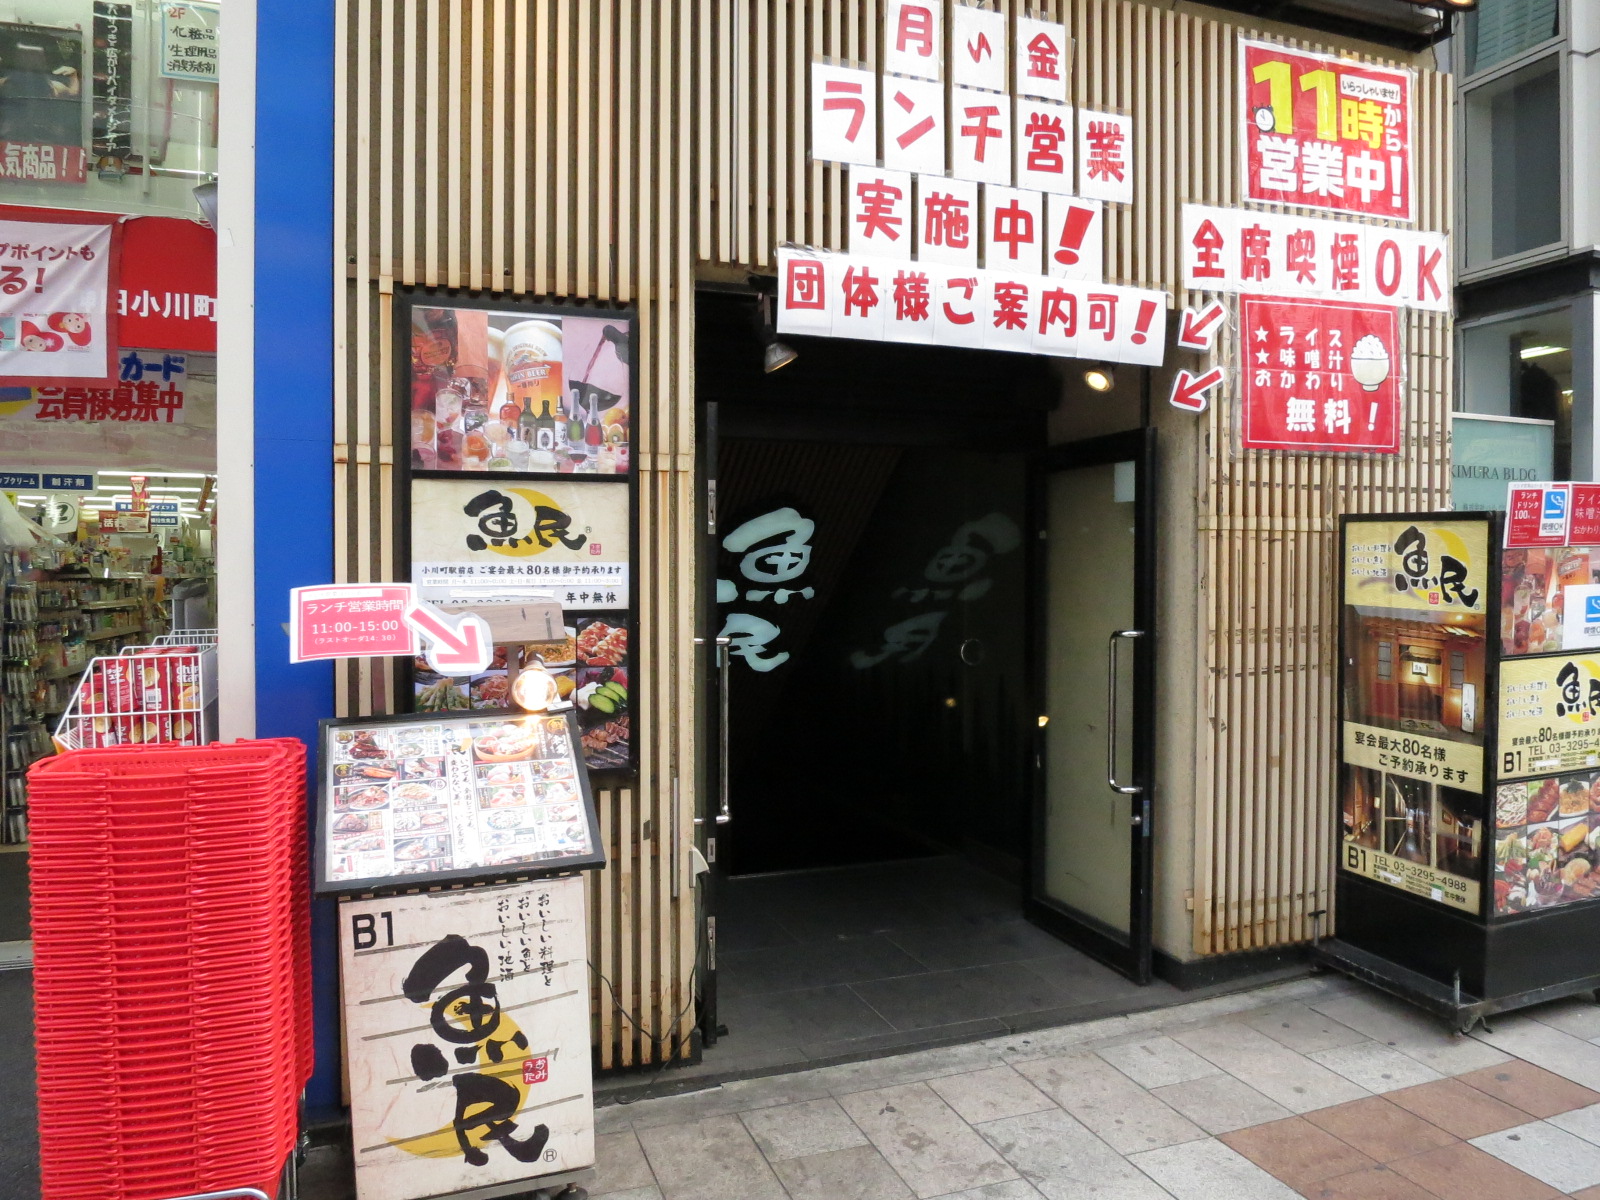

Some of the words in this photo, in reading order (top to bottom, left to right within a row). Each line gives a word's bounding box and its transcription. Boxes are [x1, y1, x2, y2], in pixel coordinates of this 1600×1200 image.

[168, 7, 186, 19] 2F
[169, 44, 217, 58] 生理用品
[822, 79, 1126, 184] ランチ営業
[0, 141, 85, 179] 気商品!!
[1256, 135, 1403, 209] 営業中!
[855, 178, 1095, 266] 実施中!
[1192, 218, 1443, 303] 全席喫煙OK
[785, 258, 1158, 346] 団体様ご案内可!
[118, 351, 186, 382] カード
[1279, 347, 1344, 370] 味噌汁
[1254, 369, 1344, 392] おかわり
[463, 489, 588, 552] 魚民
[1393, 525, 1479, 608] 魚民
[306, 599, 404, 615] ランチ営業時間
[565, 592, 618, 604] 年中無休
[1354, 731, 1447, 762] 宴会最大80名様
[1503, 750, 1522, 773] B1
[1528, 745, 1546, 756] TEL
[1378, 753, 1469, 784] ご予約承ります
[1347, 845, 1367, 873] B1
[1373, 853, 1390, 868] TEL
[1393, 861, 1467, 892] 03-3295-4988
[351, 910, 394, 950] B1
[496, 898, 514, 982] おいしい地酒
[517, 896, 533, 973] おいしい魚と
[538, 893, 554, 987] おいしい料理と
[402, 933, 550, 1167] 魚民
